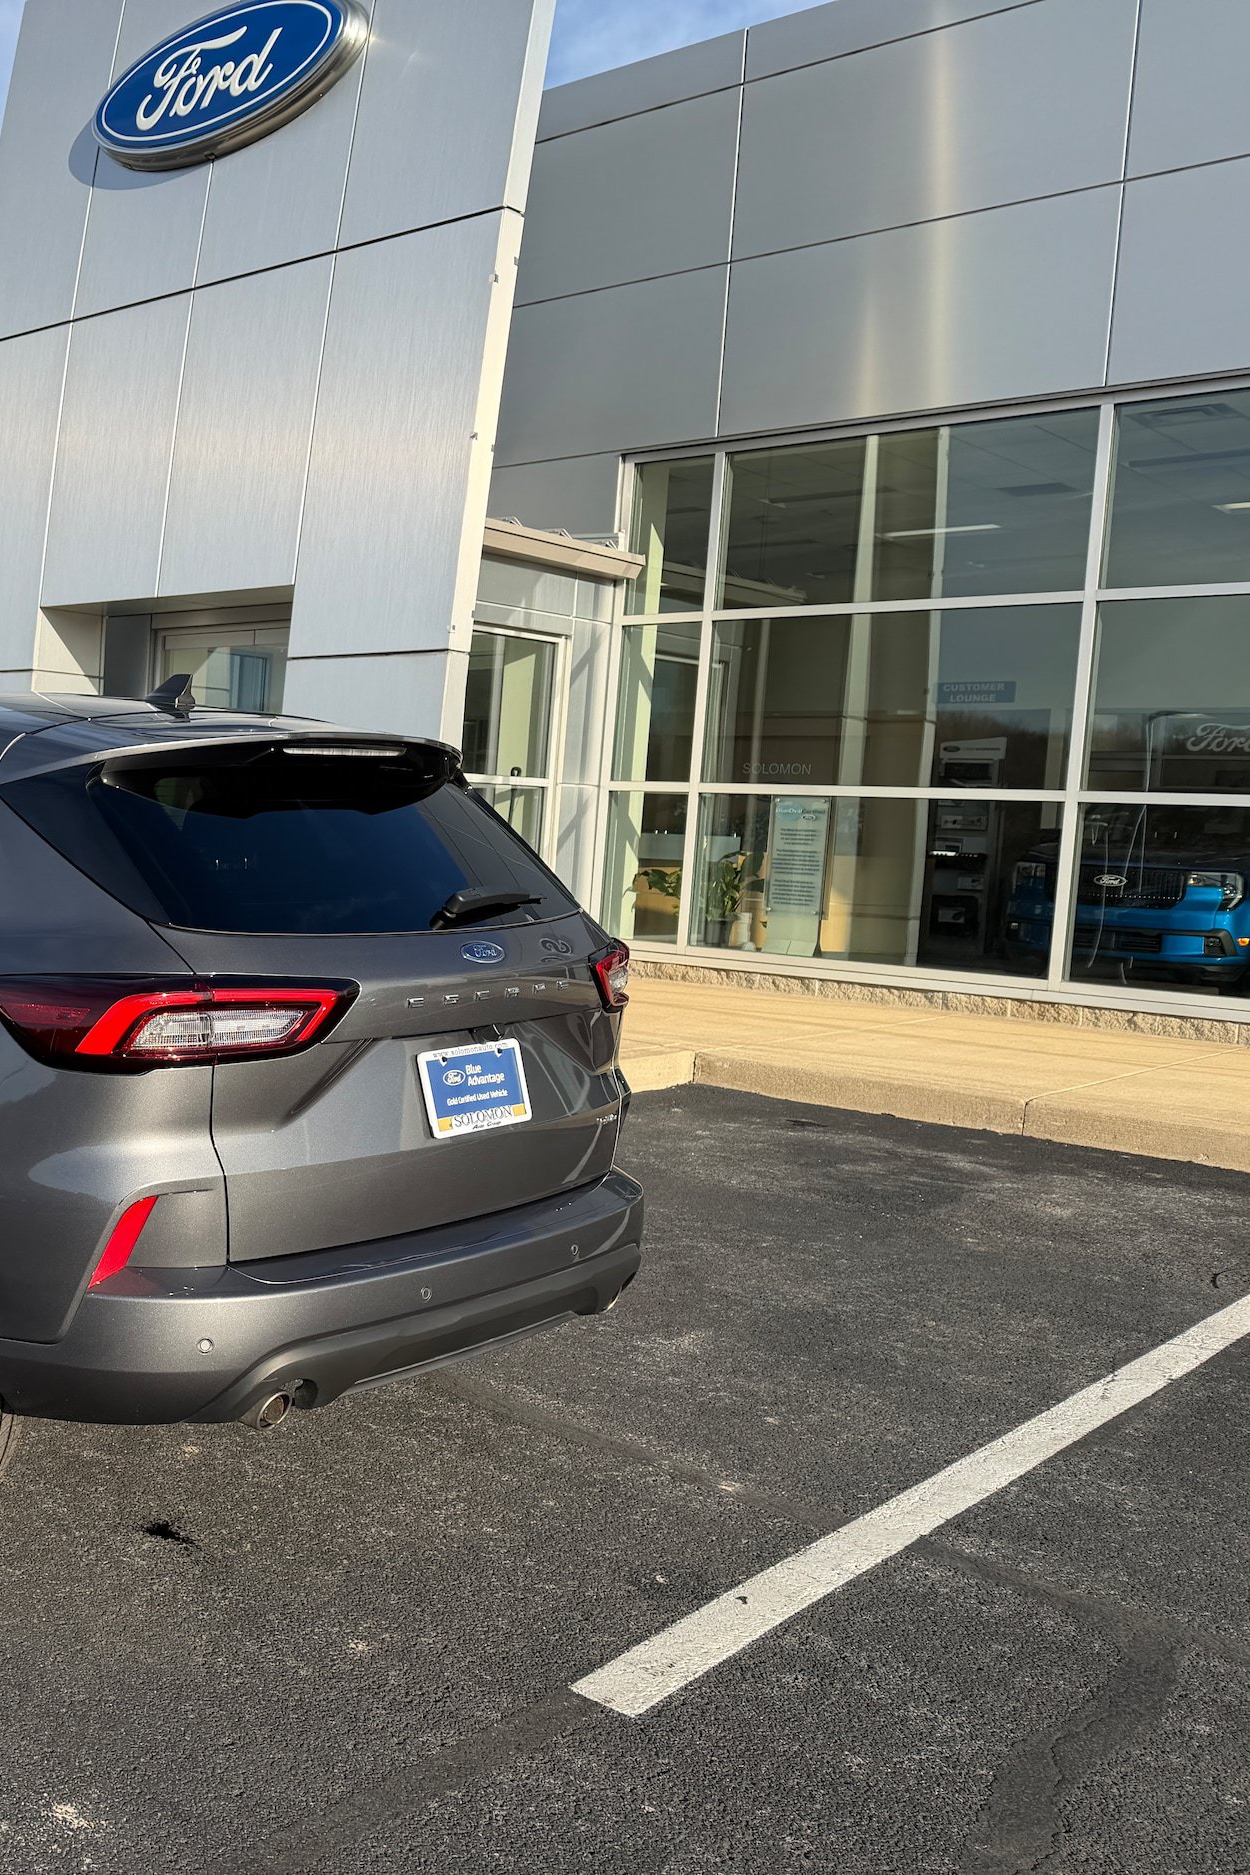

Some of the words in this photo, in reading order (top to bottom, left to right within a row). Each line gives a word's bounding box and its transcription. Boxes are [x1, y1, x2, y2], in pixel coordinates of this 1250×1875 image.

[135, 25, 283, 131] Ford
[943, 683, 1006, 692] CUSTOMER
[950, 694, 997, 703] LOUNGE
[742, 762, 812, 775] SOLOMON
[1100, 875, 1121, 885] Ford
[465, 1064, 482, 1075] Blue
[467, 1072, 505, 1087] Advantage
[446, 1096, 458, 1106] Gold
[458, 1094, 477, 1104] Certified
[476, 1091, 490, 1101] Used
[489, 1089, 509, 1099] Vehicle
[453, 1105, 513, 1128] SOLOMON
